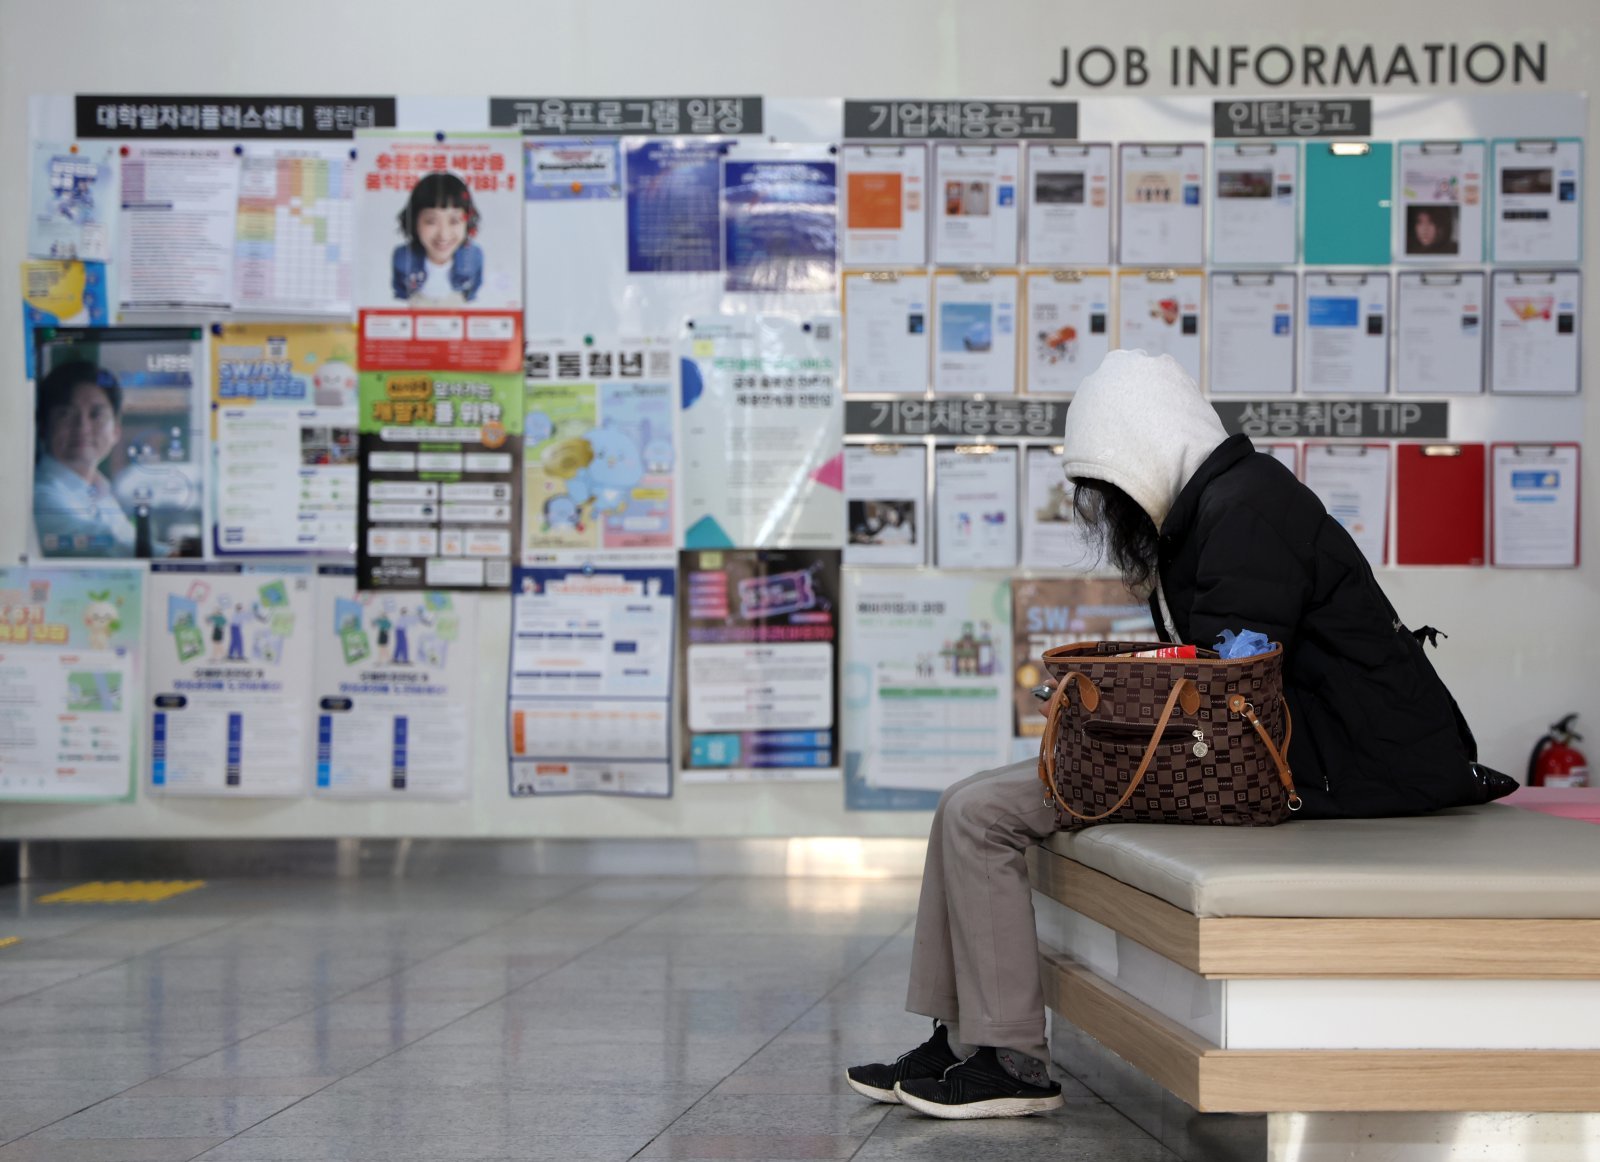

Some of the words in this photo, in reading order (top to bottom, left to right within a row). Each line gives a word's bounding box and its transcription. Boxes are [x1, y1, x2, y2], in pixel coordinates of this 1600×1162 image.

[1050, 46, 1149, 88] JOB
[1171, 42, 1547, 87] INFORMATION
[97, 105, 304, 131] 대학일자리플러스센터
[313, 105, 375, 130] 캘린더
[513, 99, 679, 134] 교육프로그램
[687, 99, 743, 133] 일정
[868, 102, 1055, 138] 기업채용공고
[1228, 100, 1355, 136] 인턴공고
[870, 400, 1056, 435] 기업채용동향
[1238, 402, 1363, 436] 성공취업
[1372, 403, 1422, 434] TIP
[1027, 606, 1070, 632] SW
